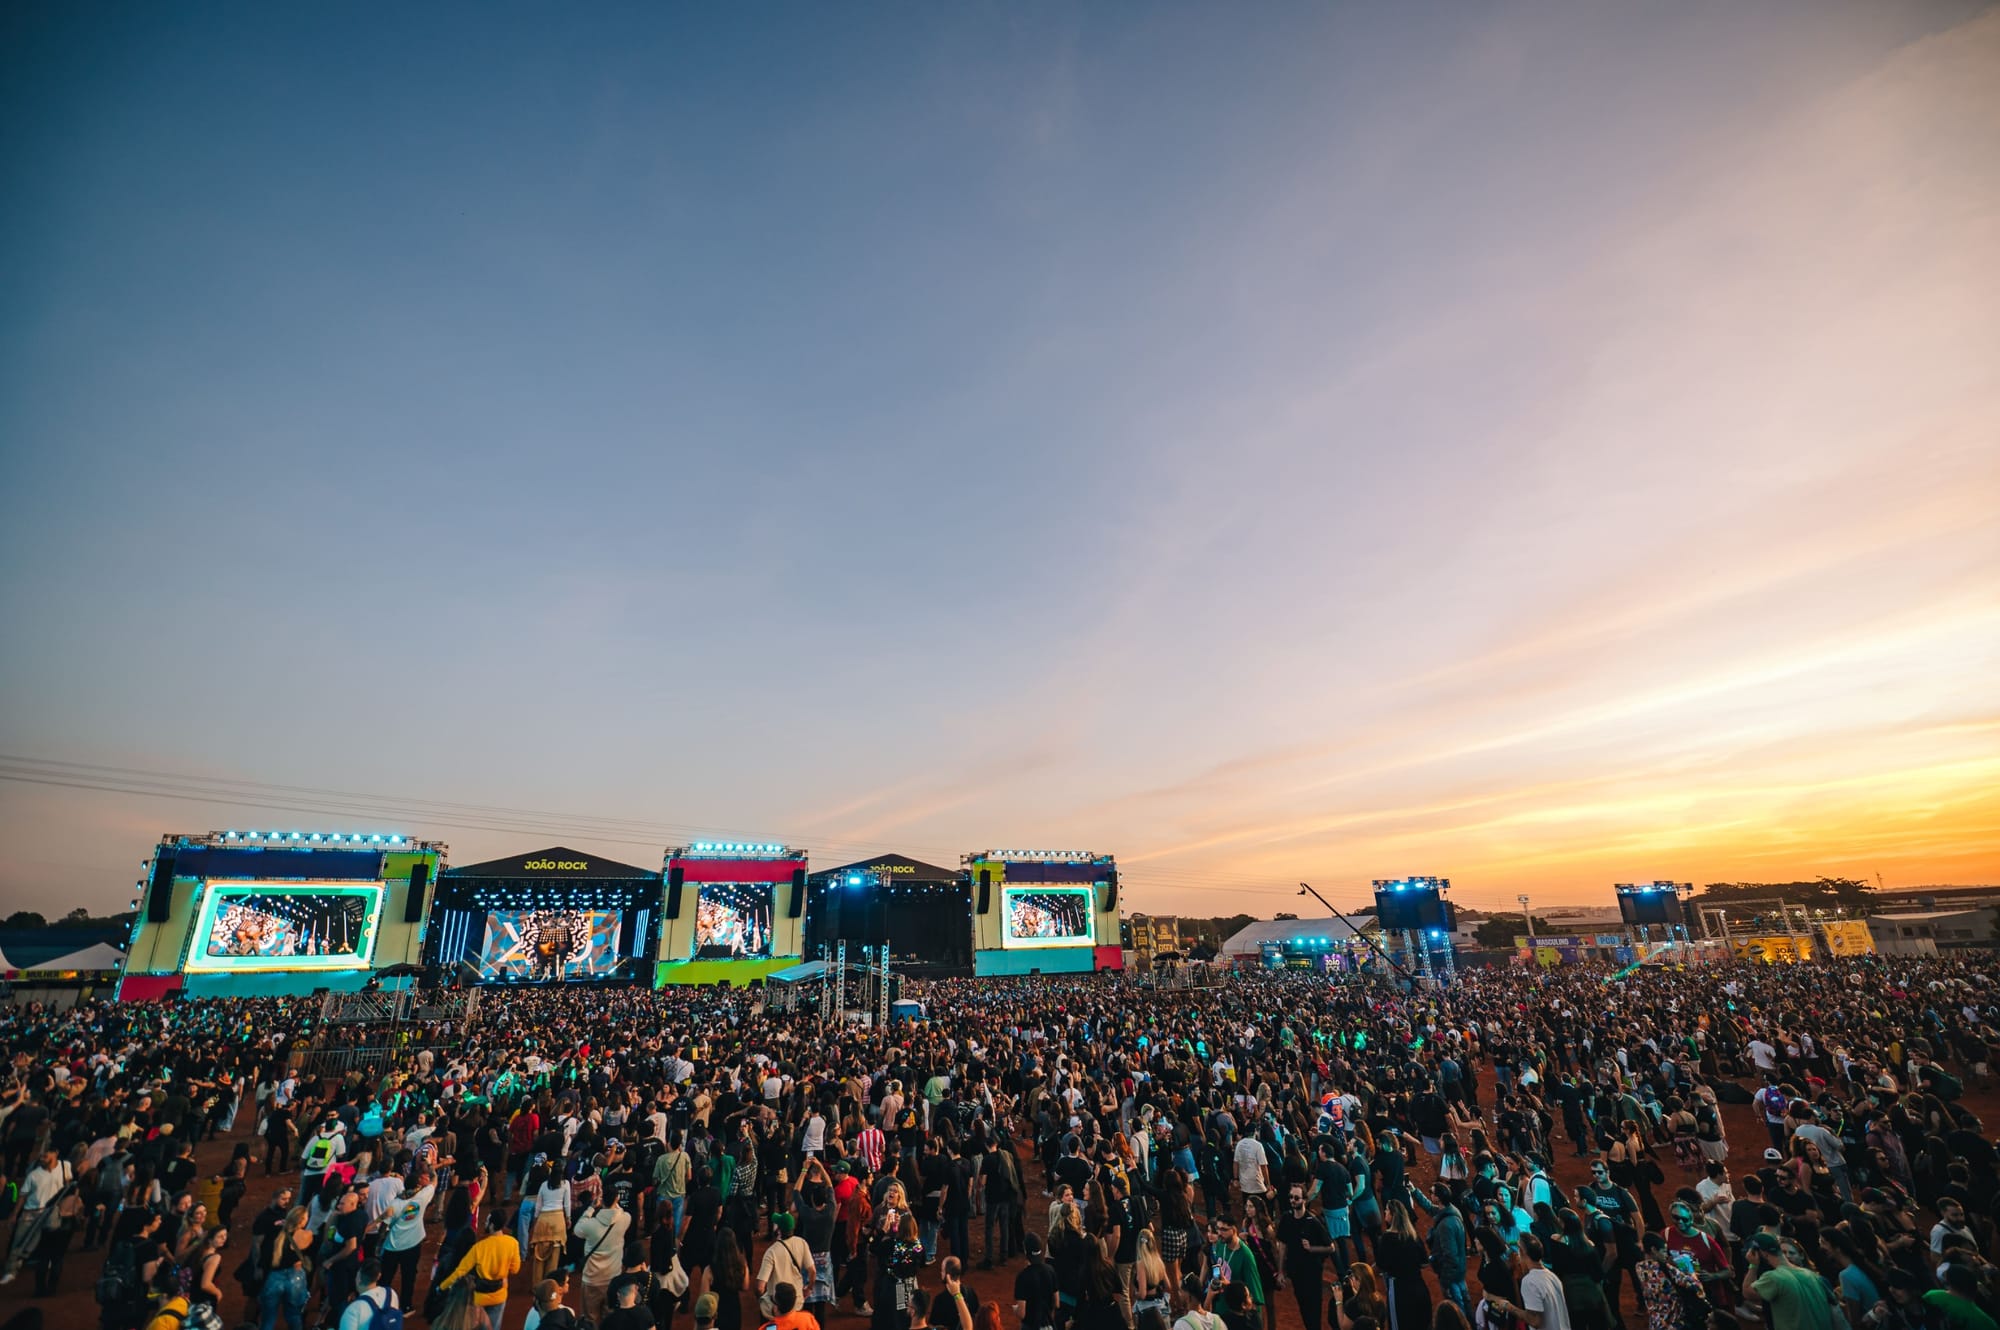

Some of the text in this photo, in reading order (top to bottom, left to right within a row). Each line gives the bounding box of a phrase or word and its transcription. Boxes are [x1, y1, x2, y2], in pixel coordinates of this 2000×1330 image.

[524, 859, 588, 870] JOÃO ROCK
[893, 865, 915, 874] ROCK
[1536, 938, 1569, 946] MASCULINO
